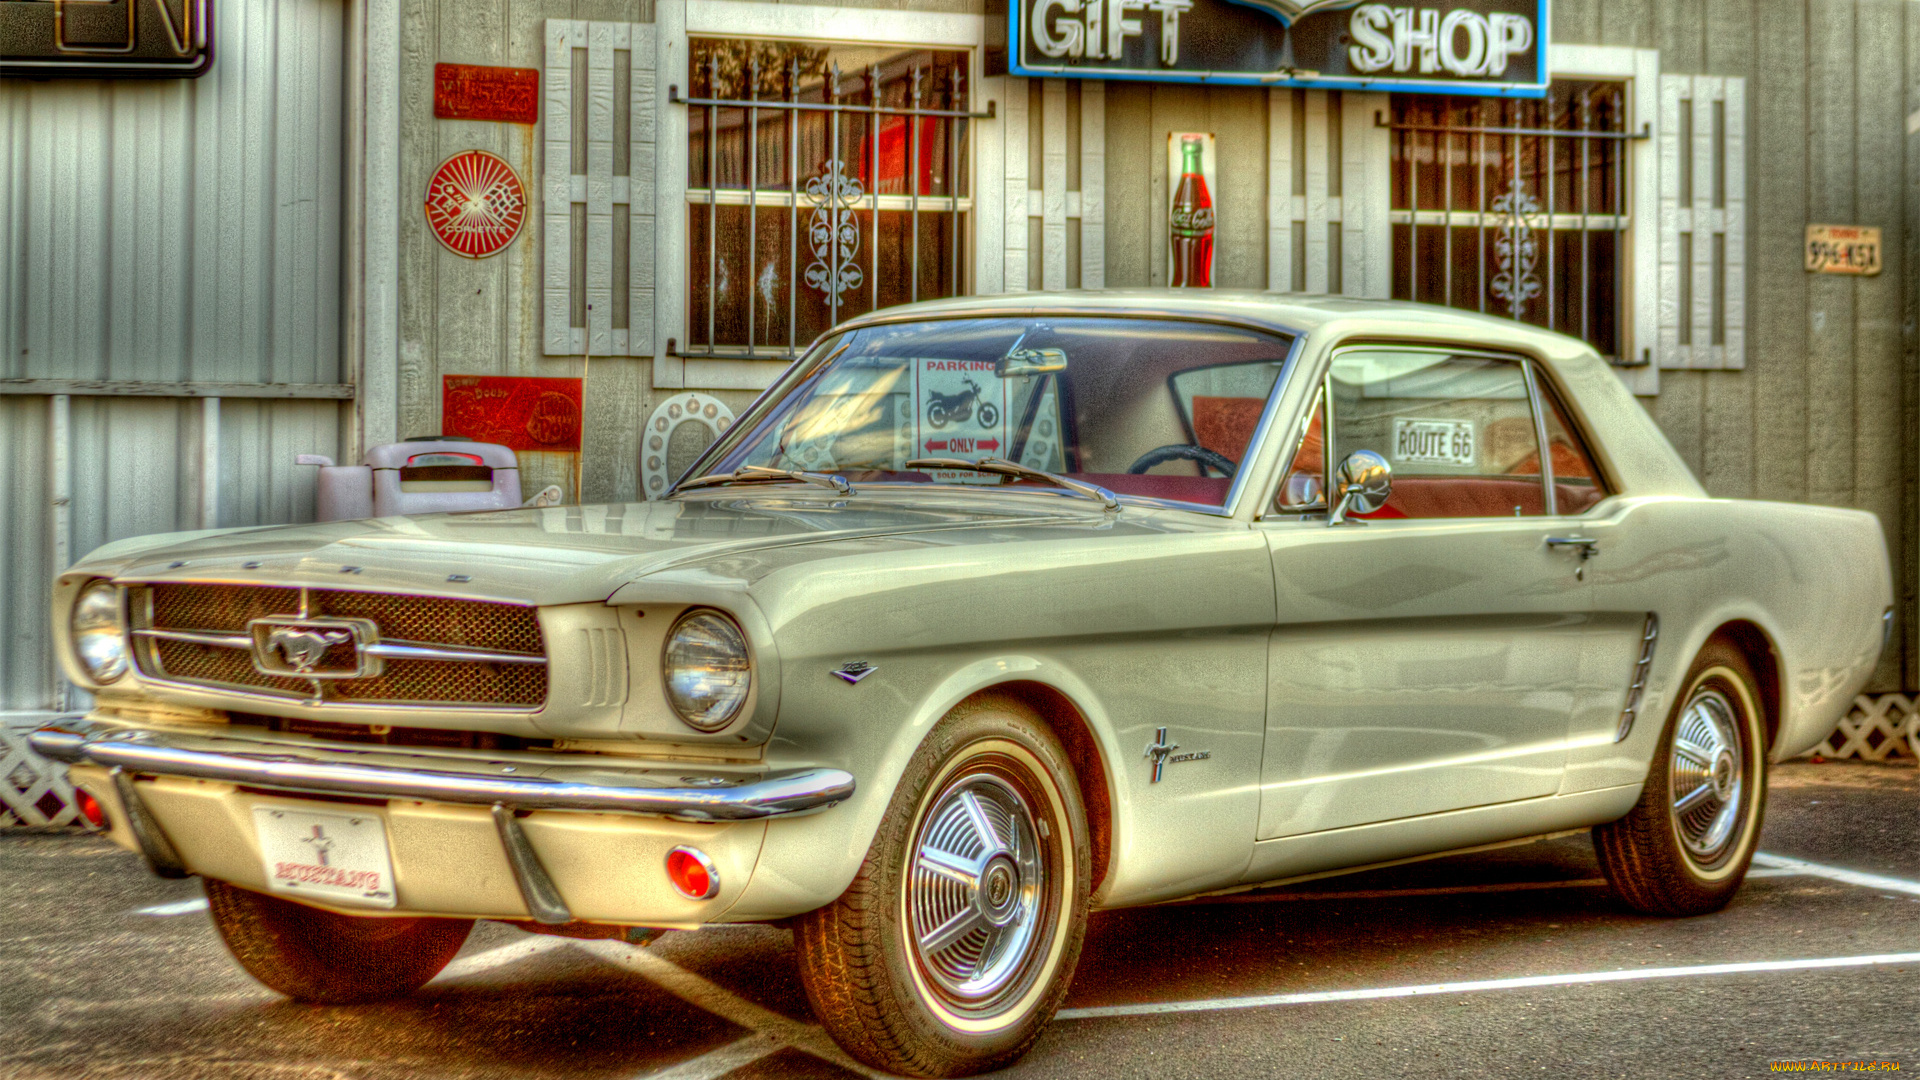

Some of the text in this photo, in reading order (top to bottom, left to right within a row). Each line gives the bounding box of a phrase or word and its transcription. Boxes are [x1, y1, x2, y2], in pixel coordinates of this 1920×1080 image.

[1031, 0, 1534, 76] GIFT SHOP
[445, 225, 506, 234] CORVETTE
[926, 361, 995, 371] PARKING
[949, 437, 975, 453] ONLY
[1398, 430, 1471, 458] ROUTE 66
[936, 471, 956, 479] SOLD
[1169, 749, 1211, 764] MUSTANG
[275, 861, 381, 890] MUSTANG
